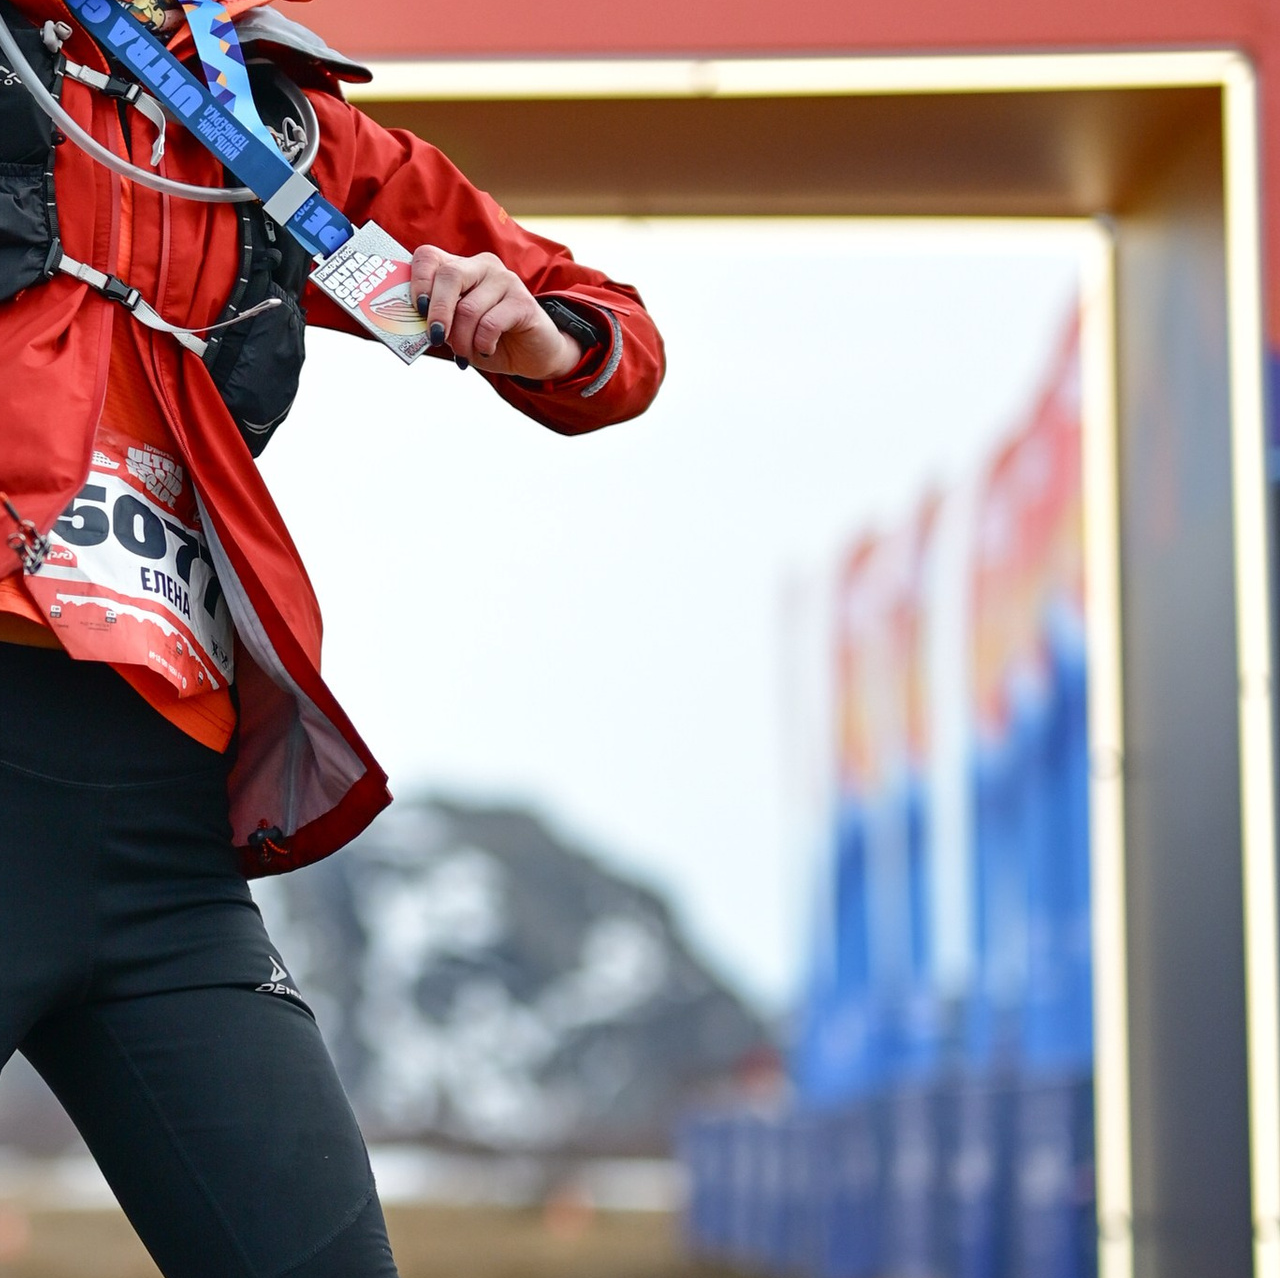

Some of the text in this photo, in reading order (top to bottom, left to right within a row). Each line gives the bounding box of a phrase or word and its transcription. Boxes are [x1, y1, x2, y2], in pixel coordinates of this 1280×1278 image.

[107, 16, 204, 119] ULTRA
[322, 252, 368, 291] ULTRA
[334, 255, 383, 299] GRAND
[344, 259, 398, 309] ESCAPE
[140, 566, 191, 620] ЕЛЕНА
